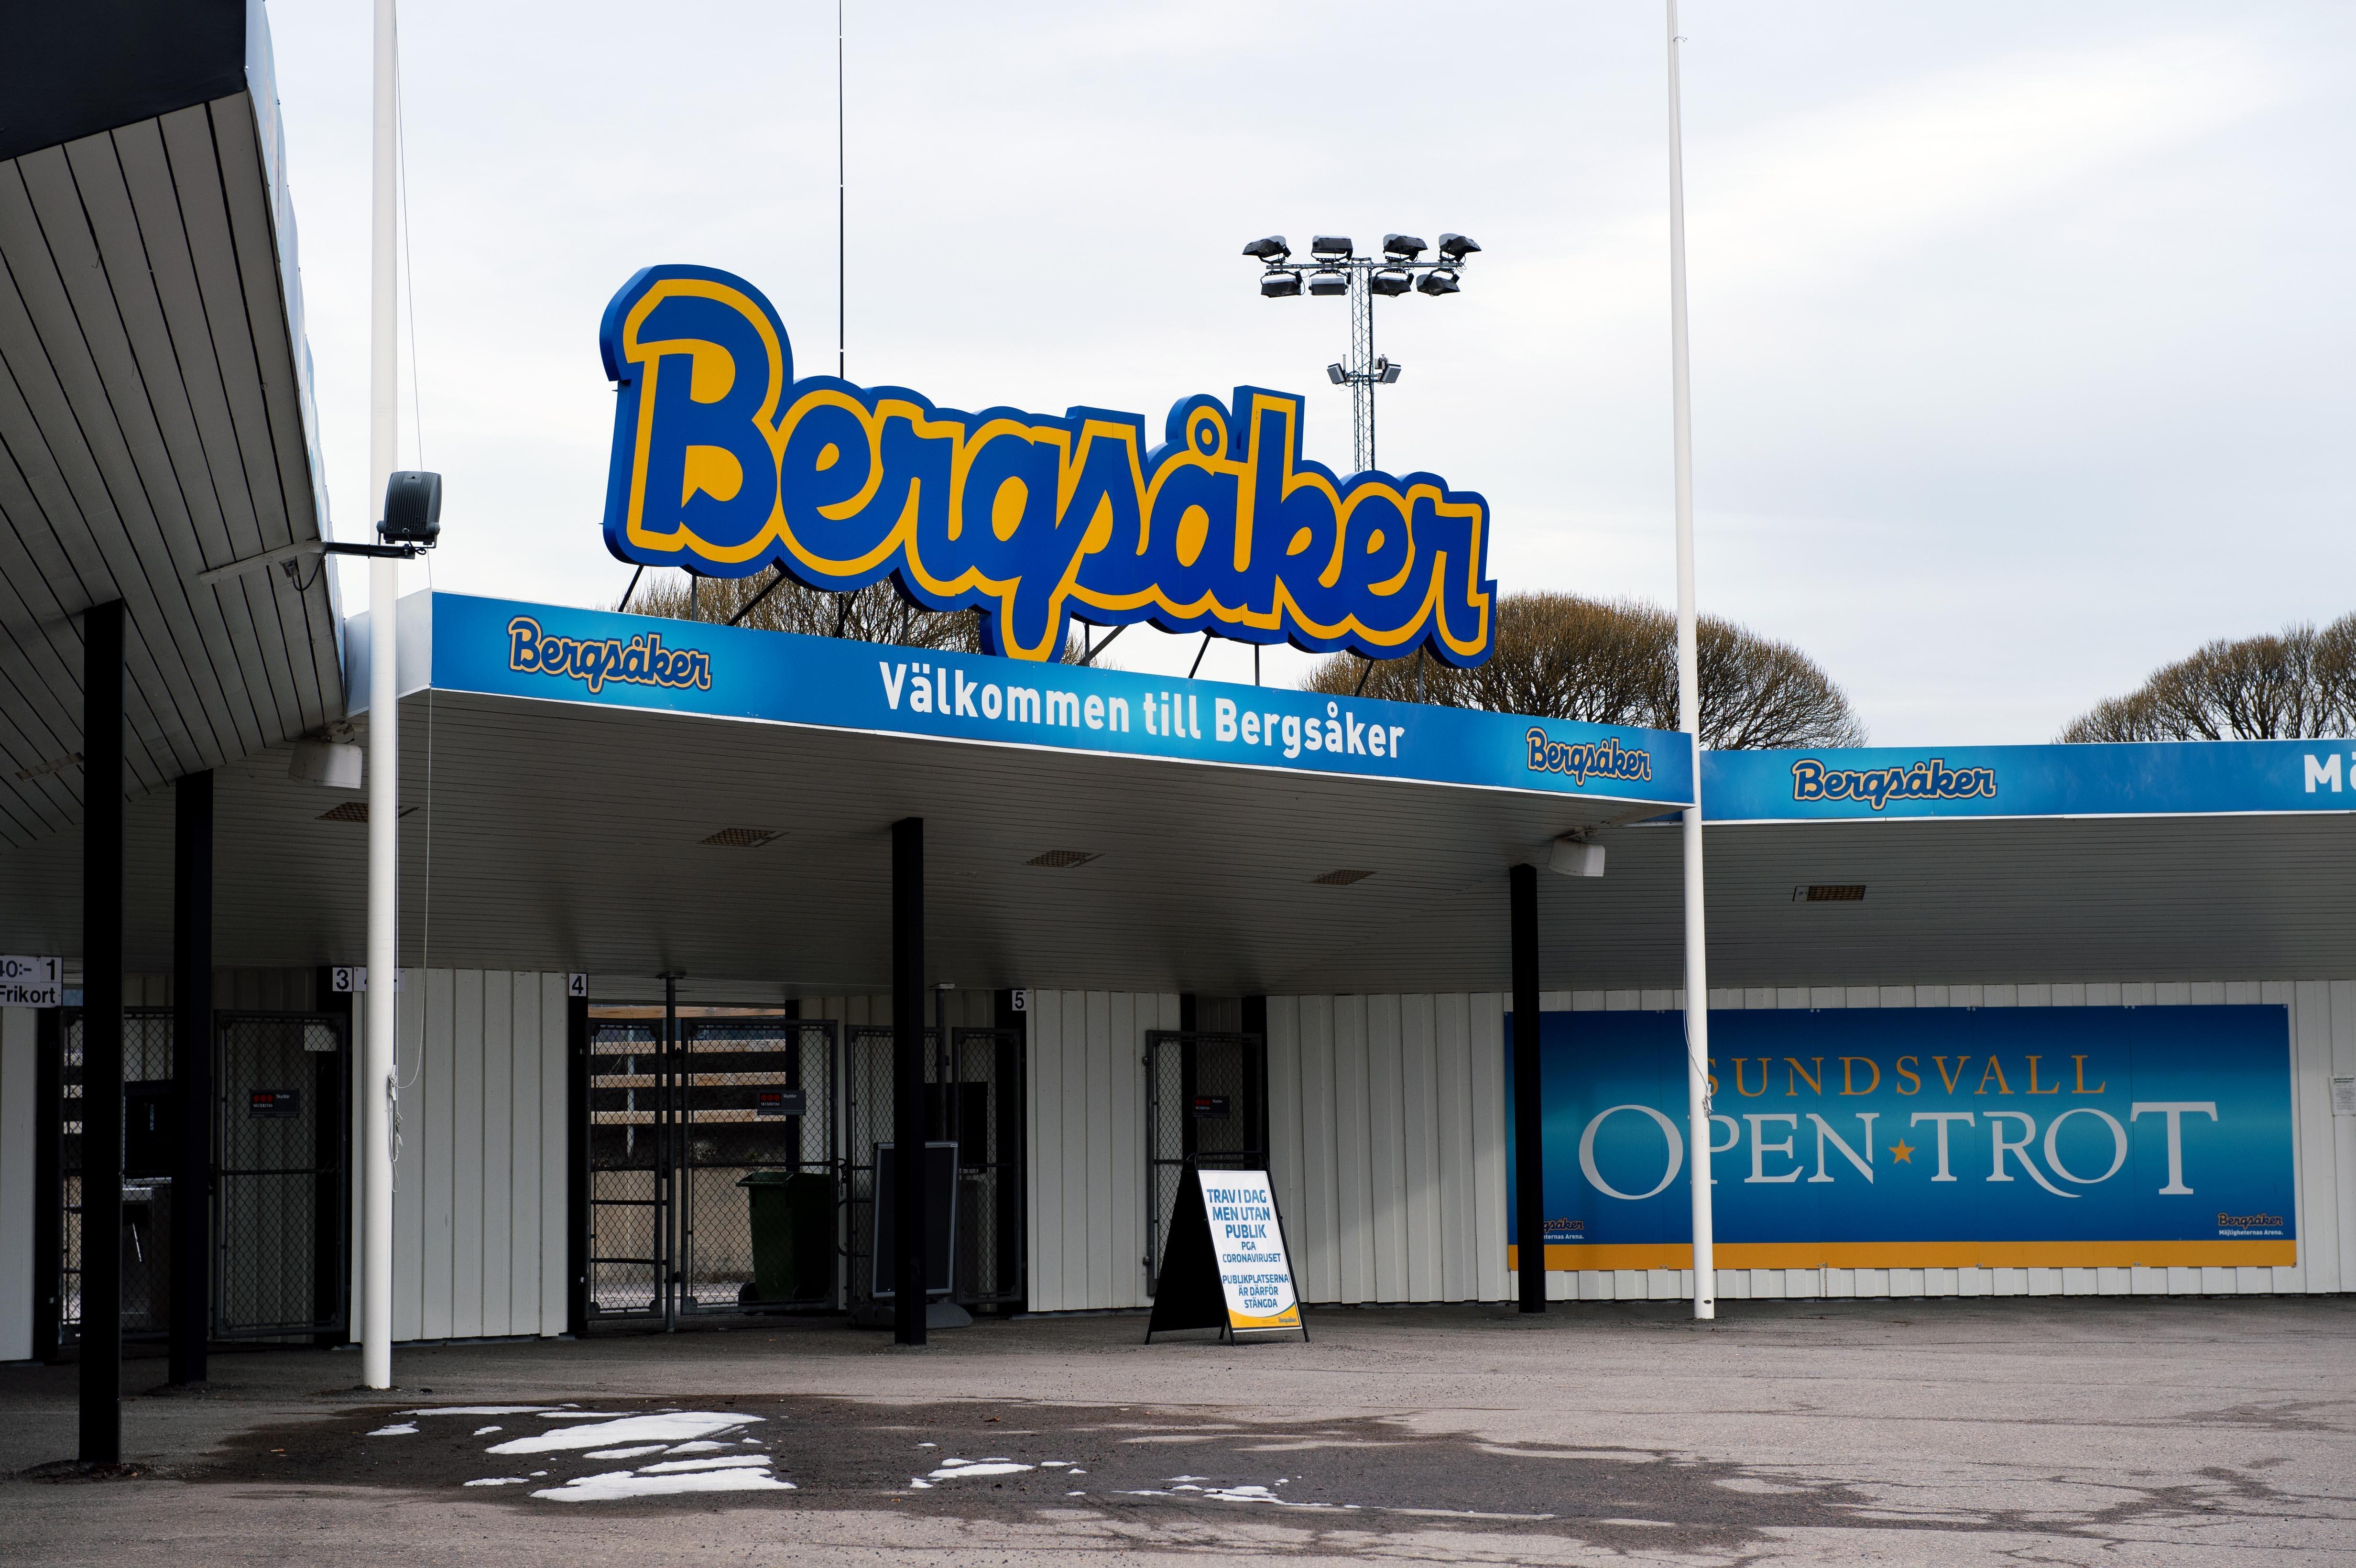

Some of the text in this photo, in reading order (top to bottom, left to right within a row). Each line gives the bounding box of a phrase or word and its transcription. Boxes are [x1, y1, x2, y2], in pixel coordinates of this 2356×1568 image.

[617, 275, 1496, 665] Bergsåker
[507, 617, 712, 694] Bergsåker
[879, 661, 1405, 759] Välkommen till Bergsåker
[1526, 726, 1653, 787] Bergsåker
[2304, 752, 2356, 793] M
[1792, 757, 1999, 811] Bergsåker
[46, 959, 55, 980] 1
[336, 969, 349, 990] 3
[572, 976, 584, 994] 4
[0, 985, 55, 1003] Frikort
[1015, 992, 1024, 1009] 5
[1579, 1102, 2218, 1200] OPEN TROT
[1207, 1189, 1266, 1203] TRAV I DAG
[1212, 1207, 1270, 1221] MEN UTAN
[2218, 1213, 2283, 1229] Bergsåker
[1225, 1224, 1266, 1238] PUBLIK
[1241, 1241, 1256, 1251] PGA
[1222, 1253, 1281, 1263] CORONAVIRUSET
[1222, 1274, 1289, 1284] PUBLIKPLATSERNA
[1238, 1284, 1278, 1296] ÄR DÄRFÖR
[1244, 1297, 1278, 1308] STÄNGDA
